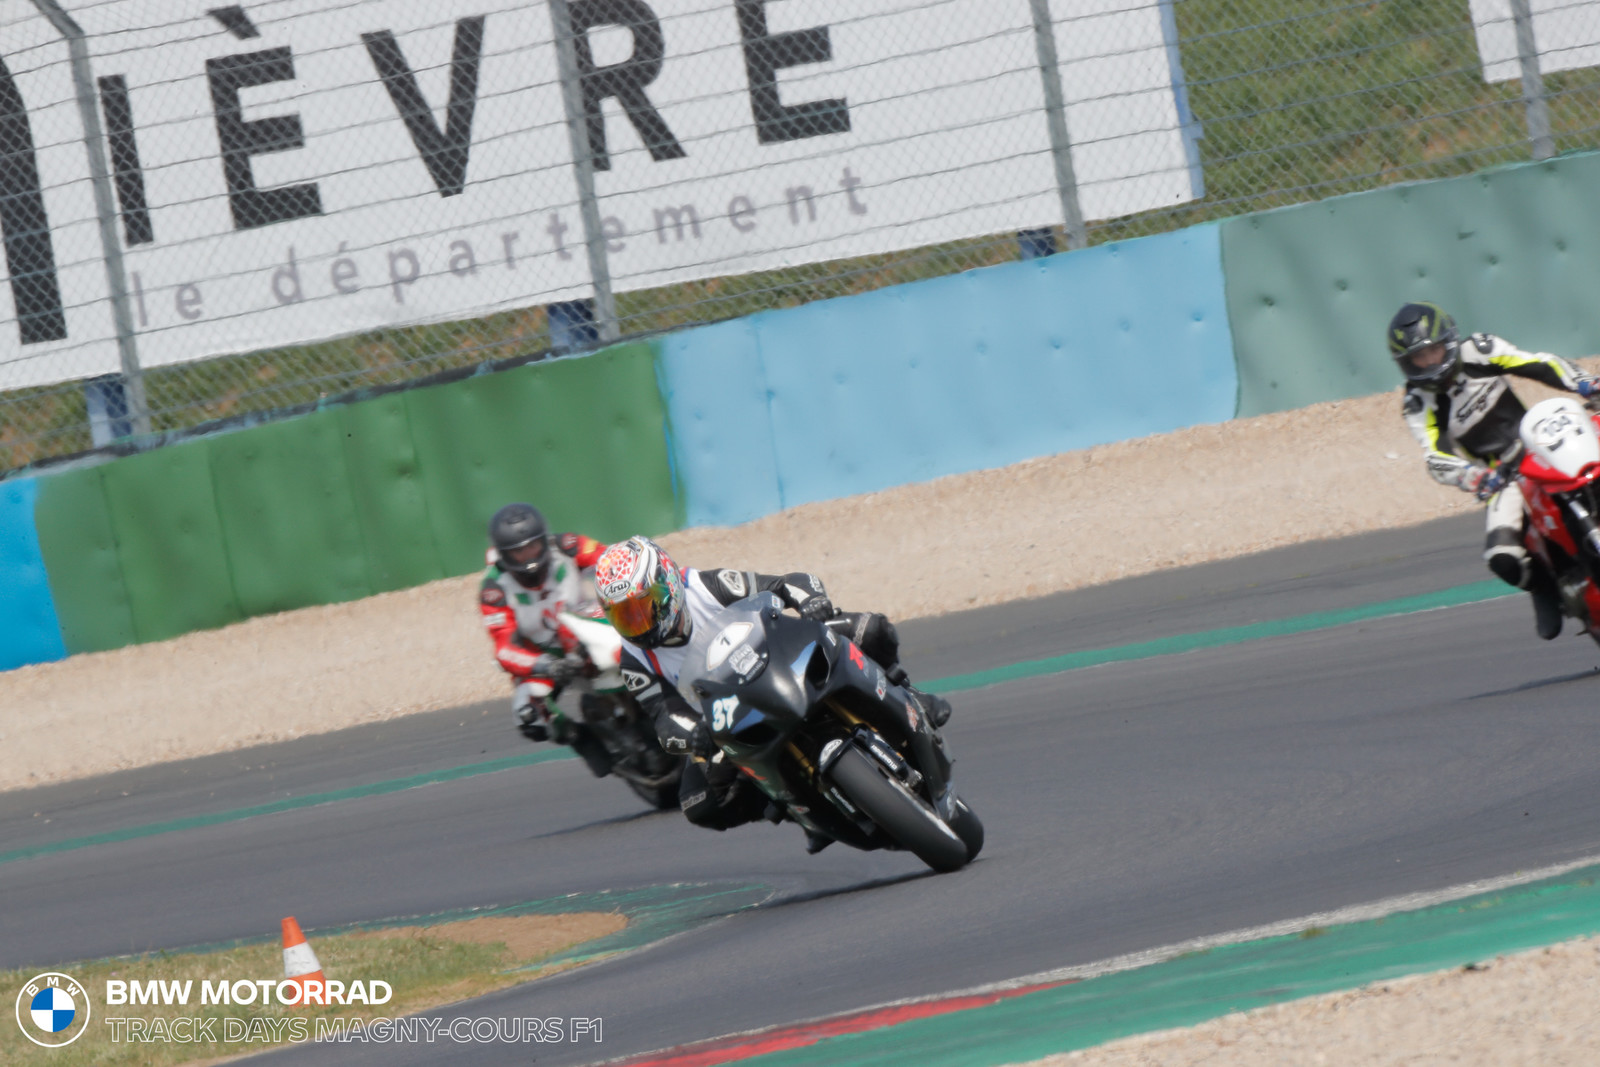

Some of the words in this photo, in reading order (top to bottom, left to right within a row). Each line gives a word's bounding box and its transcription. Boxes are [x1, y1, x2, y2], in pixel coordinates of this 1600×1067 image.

[131, 270, 203, 328] le
[270, 166, 869, 306] département
[606, 582, 628, 596] Arai
